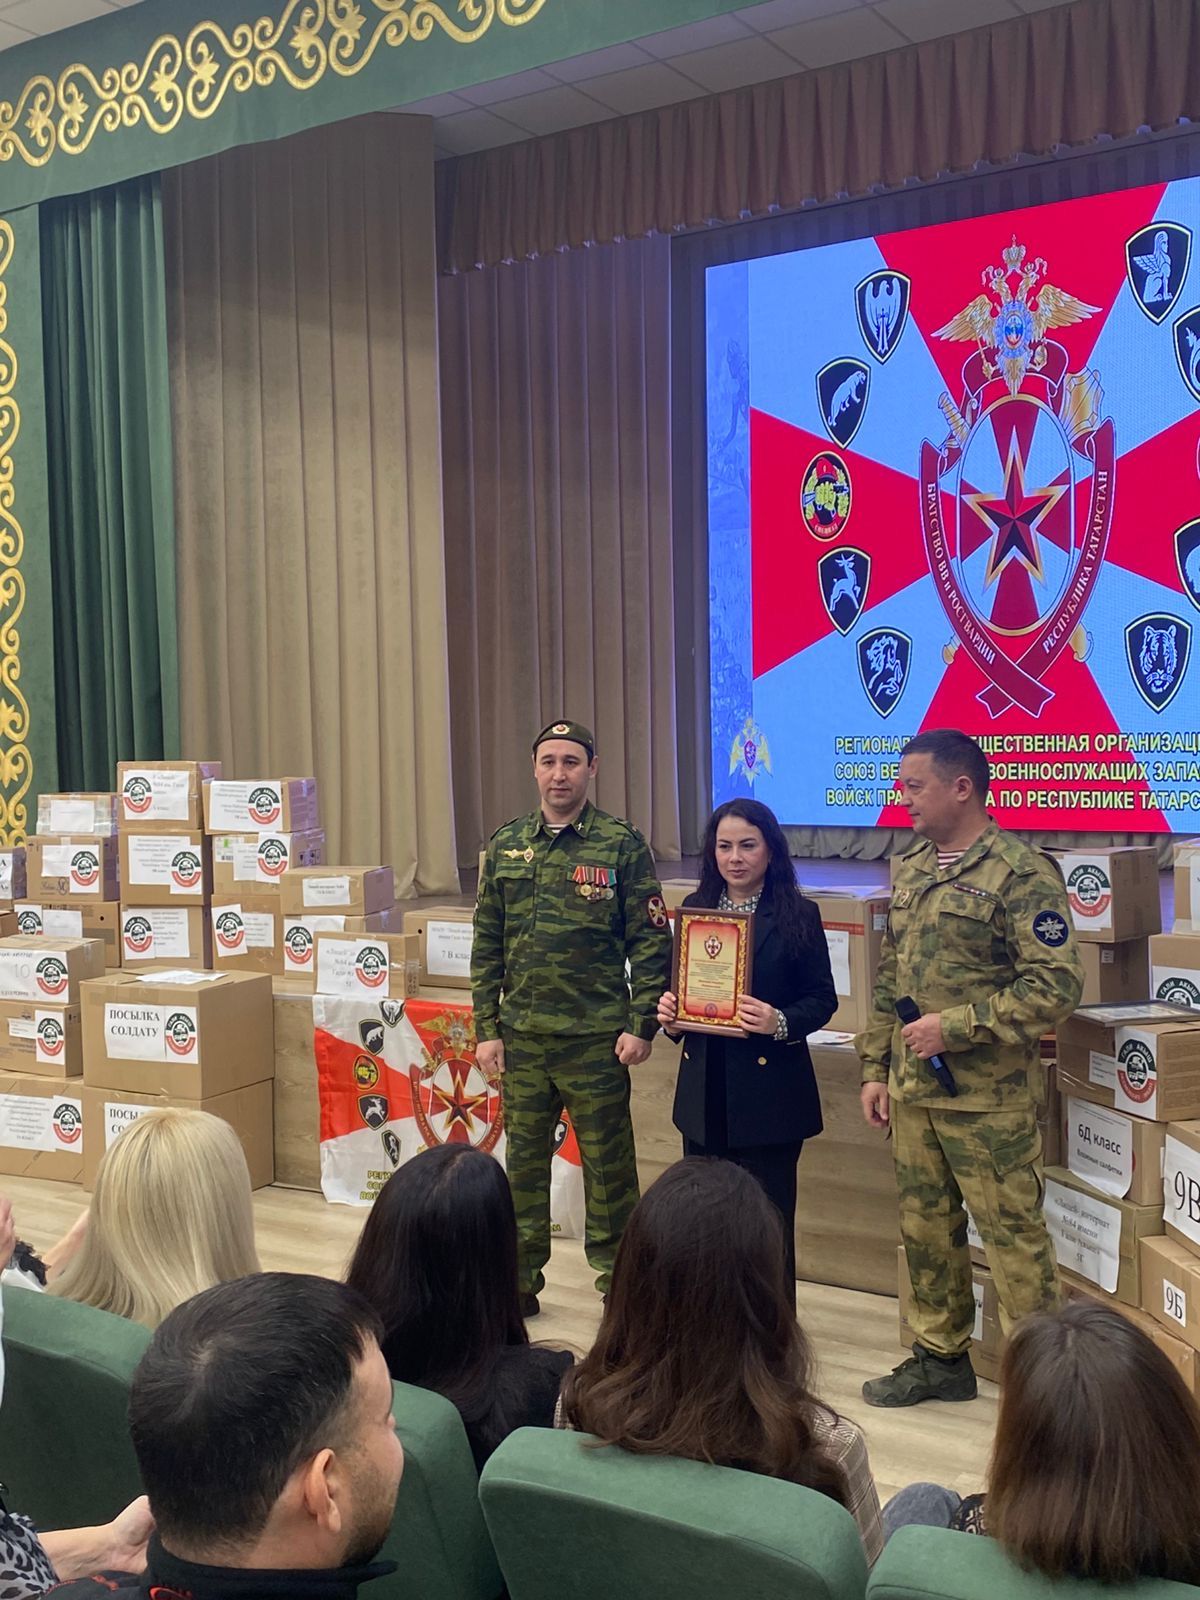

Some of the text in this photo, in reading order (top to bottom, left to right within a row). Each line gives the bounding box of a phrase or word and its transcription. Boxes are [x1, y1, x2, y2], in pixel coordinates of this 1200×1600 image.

[927, 483, 943, 559] БРАТСТВО
[938, 560, 949, 580] ВВ
[948, 591, 996, 665] РОСГВАРДИИ
[1042, 471, 1108, 654] РЕСПУБЛИКА ТАТАРСТАН
[970, 734, 1090, 756] ЩЕСТВЕННАЯ
[1094, 732, 1200, 756] ОРГАНИЗАЦ
[834, 762, 876, 780] СОЮЗ
[880, 762, 900, 780] ВЕ
[988, 762, 1149, 784] ВОЕННОСЛУЖАЩИХ
[826, 784, 874, 806] ВОЙСК
[877, 788, 903, 807] ПРА
[1000, 790, 1022, 808] ПО
[1027, 790, 1135, 809] РЕСПУБЛИКЕ
[1159, 980, 1175, 996] ГАЛИ
[110, 1009, 160, 1021] ПОСЫЛКА
[111, 1025, 159, 1037] СОЛДАТУ
[110, 1108, 140, 1120] ПОСЫ
[1078, 1123, 1121, 1155] 6Д класс
[1174, 1170, 1200, 1224] 9В
[1165, 1285, 1184, 1320] 9Б
